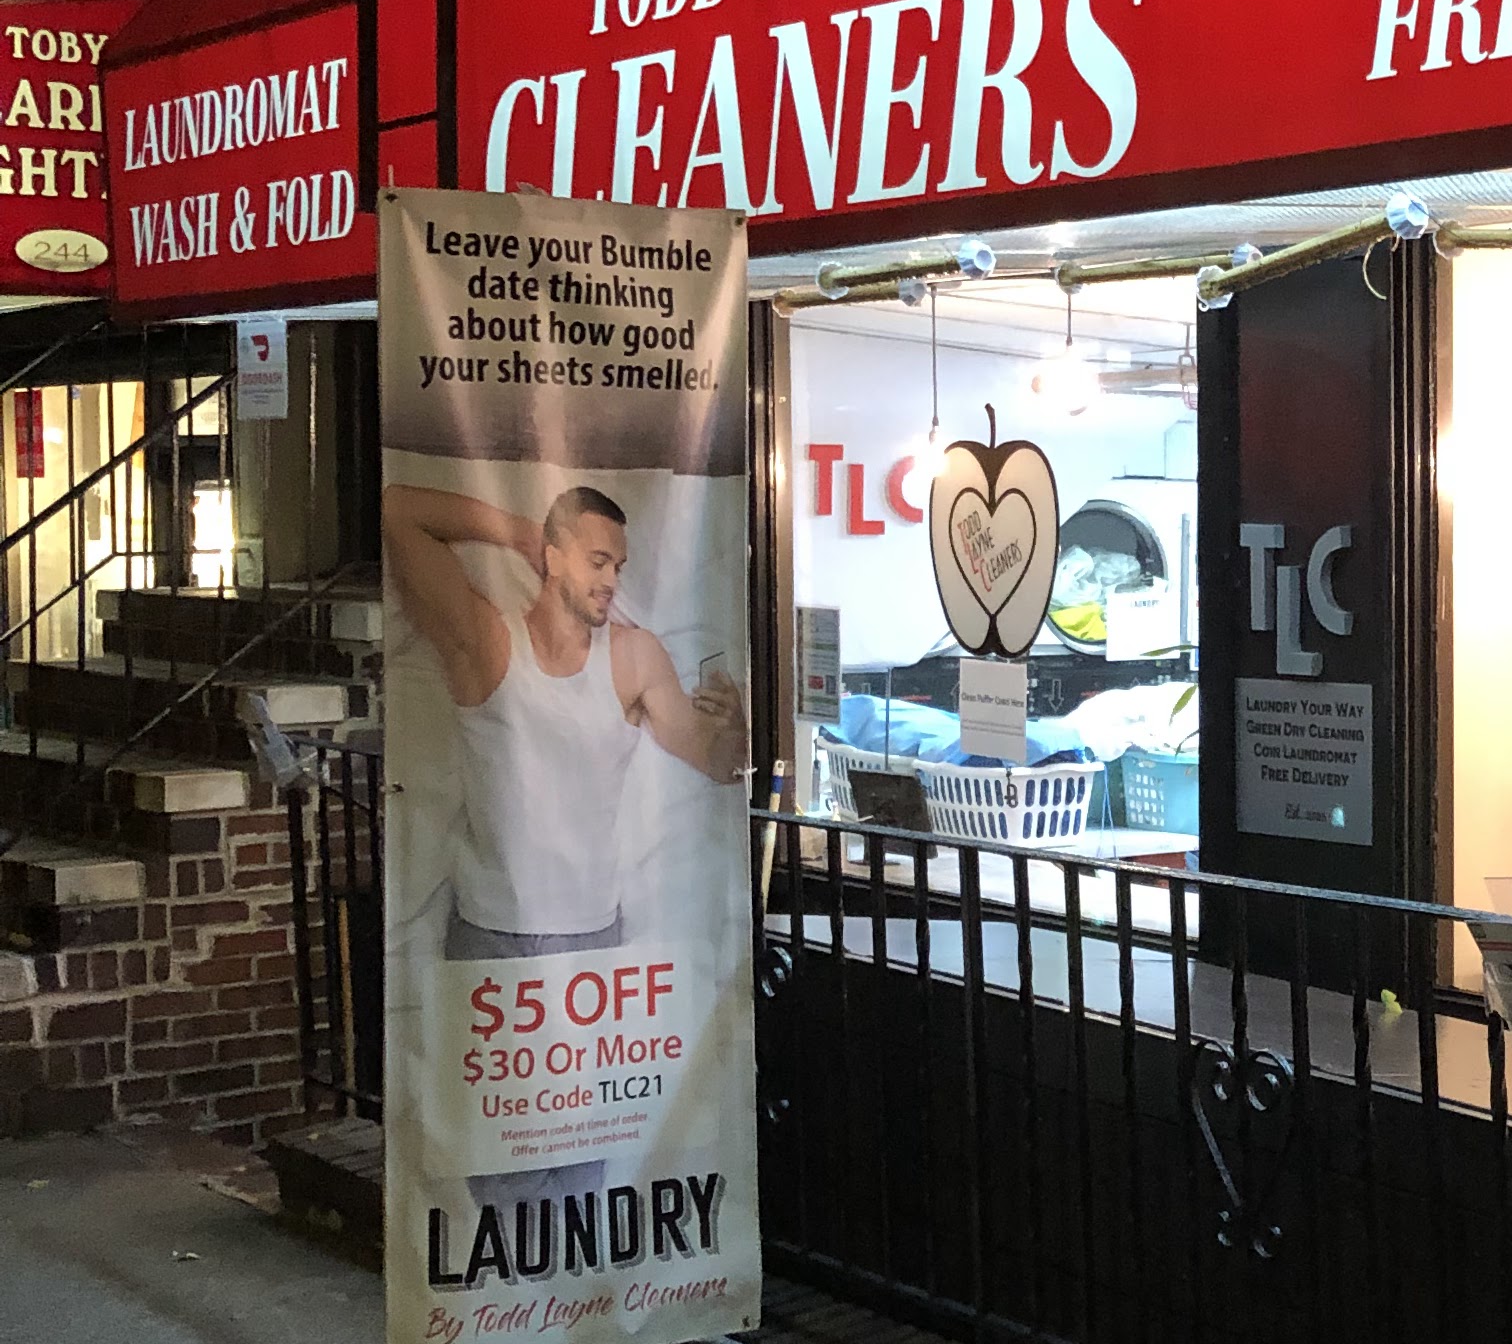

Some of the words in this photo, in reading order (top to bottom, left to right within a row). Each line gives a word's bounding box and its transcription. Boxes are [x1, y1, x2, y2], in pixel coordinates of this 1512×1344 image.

[5, 26, 109, 66] TOBY
[124, 58, 348, 172] LAUNDROMAT
[129, 192, 220, 268] WASH
[229, 186, 257, 254] &
[265, 169, 356, 248] FOLD
[34, 241, 90, 263] 244
[425, 222, 520, 259] Leave
[528, 235, 593, 269] your
[600, 234, 712, 272] Bumble
[467, 266, 540, 301] date
[548, 270, 674, 319] thinking
[448, 307, 542, 342] about
[548, 311, 615, 347] how
[623, 319, 695, 357] good
[418, 355, 490, 391] your
[496, 350, 594, 387] sheets
[601, 358, 719, 392] smelled.
[808, 443, 924, 536] TLC
[1239, 522, 1354, 677] TLC
[1246, 696, 1297, 714] LAUNDRY
[1300, 699, 1333, 716] YOUR
[1335, 702, 1365, 719] WAY
[1246, 719, 1281, 736] GREEN
[1283, 722, 1306, 737] DRY
[1308, 723, 1365, 742] CLEANING
[1253, 742, 1281, 758] COIN
[1283, 745, 1358, 764] LAUNDROMAT
[1260, 764, 1290, 782] FREE
[1292, 767, 1350, 787] DELIVERY
[470, 977, 546, 1042] $5
[564, 962, 674, 1026] OFF
[462, 1046, 535, 1087] $30
[544, 1042, 588, 1075] Or
[595, 1033, 683, 1069] More
[481, 1093, 529, 1119] Use
[535, 1084, 593, 1113] Code
[598, 1073, 663, 1104] TLC21
[501, 1127, 548, 1142] Mention
[549, 1123, 574, 1137] code
[586, 1118, 609, 1131] time
[511, 1145, 540, 1157] Offer
[577, 1137, 590, 1148] be
[427, 1172, 727, 1293] LAUNDRY
[472, 1299, 538, 1339] Todd
[541, 1290, 615, 1336] Layne
[623, 1276, 729, 1314] Cleaners
